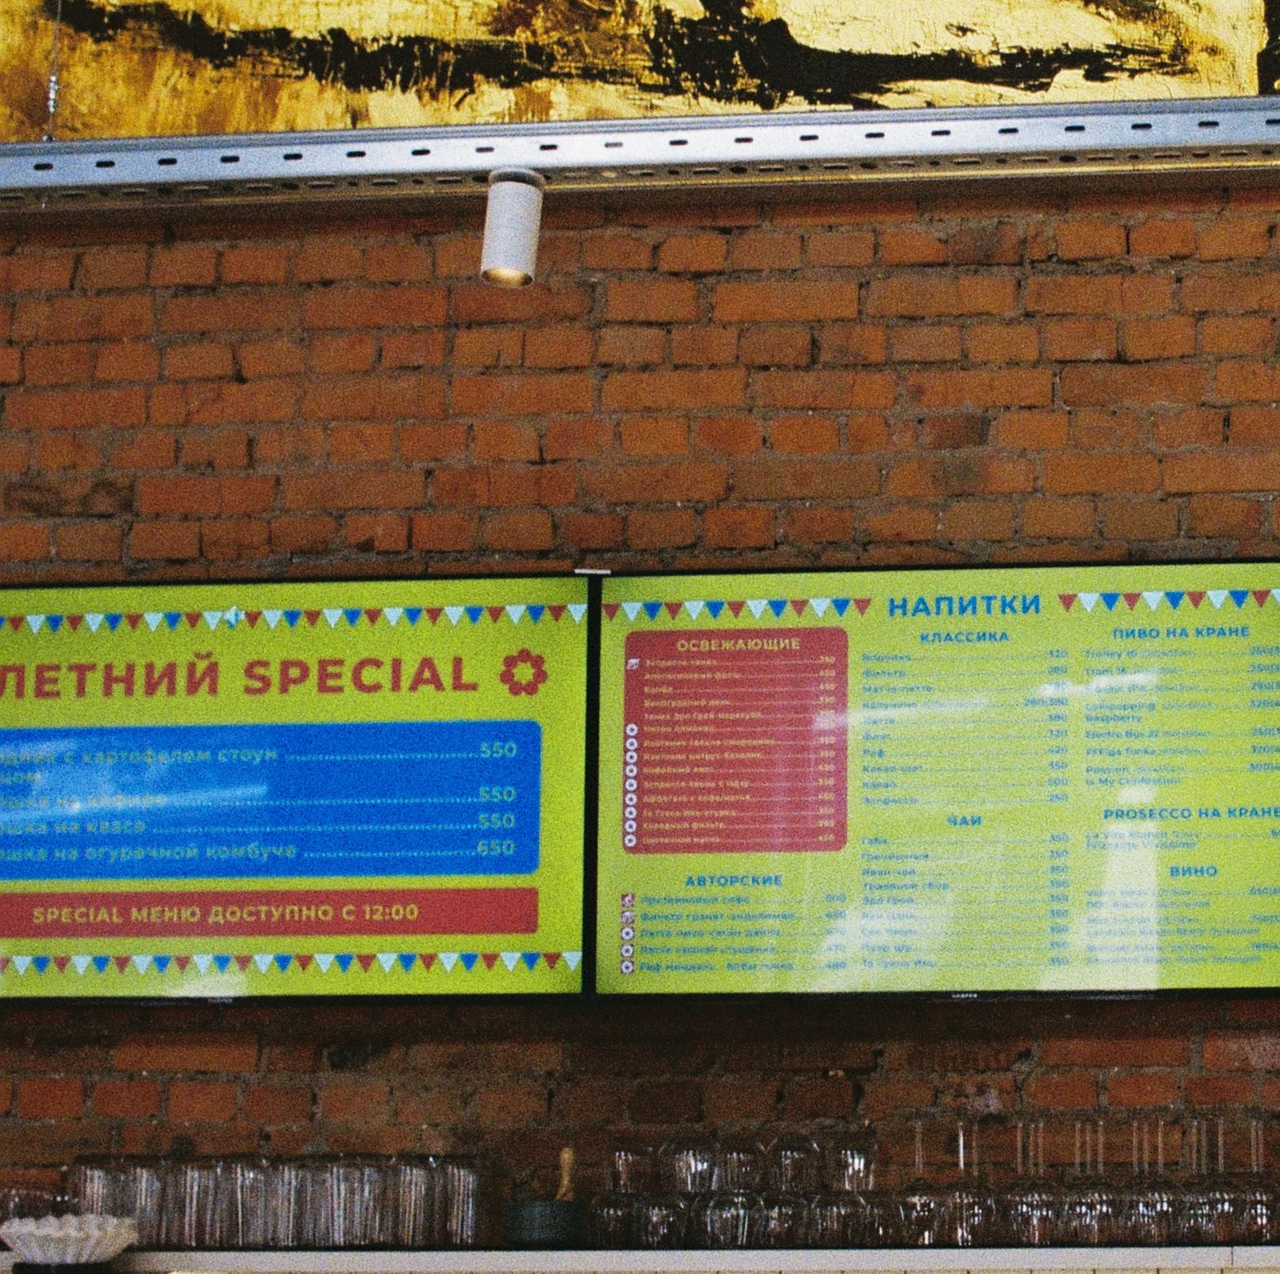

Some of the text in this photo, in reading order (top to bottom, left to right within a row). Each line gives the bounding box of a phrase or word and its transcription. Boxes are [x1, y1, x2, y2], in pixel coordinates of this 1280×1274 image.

[888, 595, 1041, 617] НАПИТКИ
[920, 631, 1010, 643] КЛАССИКА
[1112, 626, 1250, 639] ПИВО НА КРАНЕ
[677, 638, 801, 652] ОСВЕЖАЮЩИЕ
[0, 651, 479, 699] ЛЕТНИЙ SPECIAL
[218, 749, 277, 765] стоун
[479, 741, 518, 757] 550
[478, 786, 516, 802] 550
[477, 813, 516, 829] 550
[1103, 807, 1192, 820] PROSECCO
[1198, 807, 1221, 818] НА
[55, 847, 79, 860] на
[86, 841, 199, 863] огуречной
[207, 841, 297, 863] комбуче
[477, 839, 516, 856] 650
[1169, 865, 1218, 878] ВИНО
[685, 875, 783, 888] АВТОРСКИЕ
[33, 903, 418, 925] SPECIAL МЕНЮ ДОСТУПНО С 12:00
